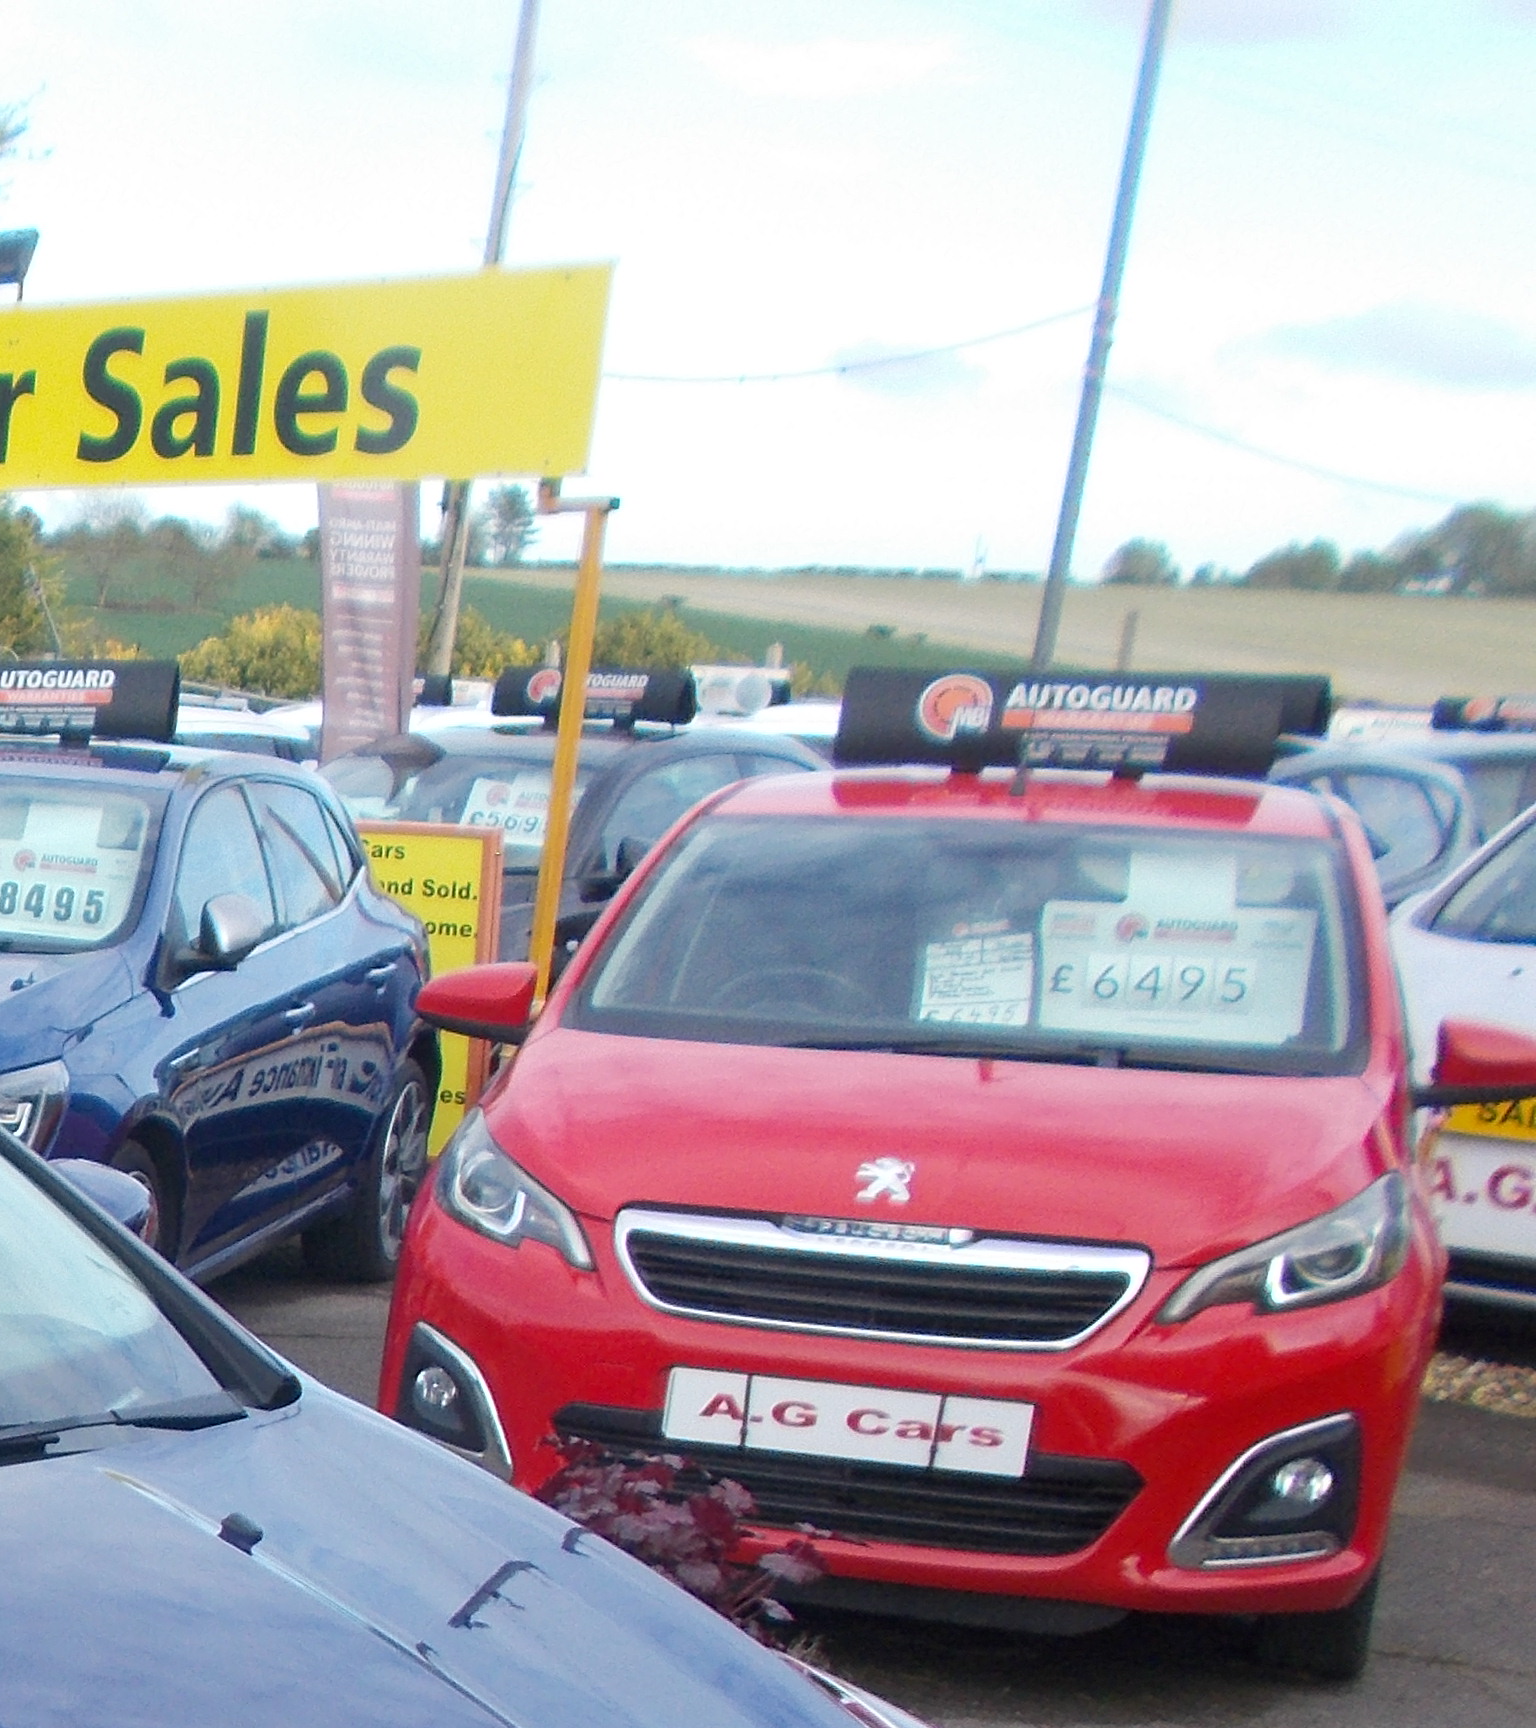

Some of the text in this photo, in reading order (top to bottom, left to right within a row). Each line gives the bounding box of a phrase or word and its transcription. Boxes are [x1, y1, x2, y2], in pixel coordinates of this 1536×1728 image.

[76, 309, 423, 464] Sales
[585, 673, 650, 689] TOGUARD
[1005, 683, 1198, 712] AUTOGUARD
[951, 706, 991, 729] MBI
[40, 853, 99, 867] AUTOGUARD
[422, 879, 478, 900] Sold.
[425, 921, 478, 938] ome.
[1156, 919, 1239, 933] AUTOGUARD
[440, 1088, 467, 1105] es
[698, 1392, 1006, 1448] A.G Cars
